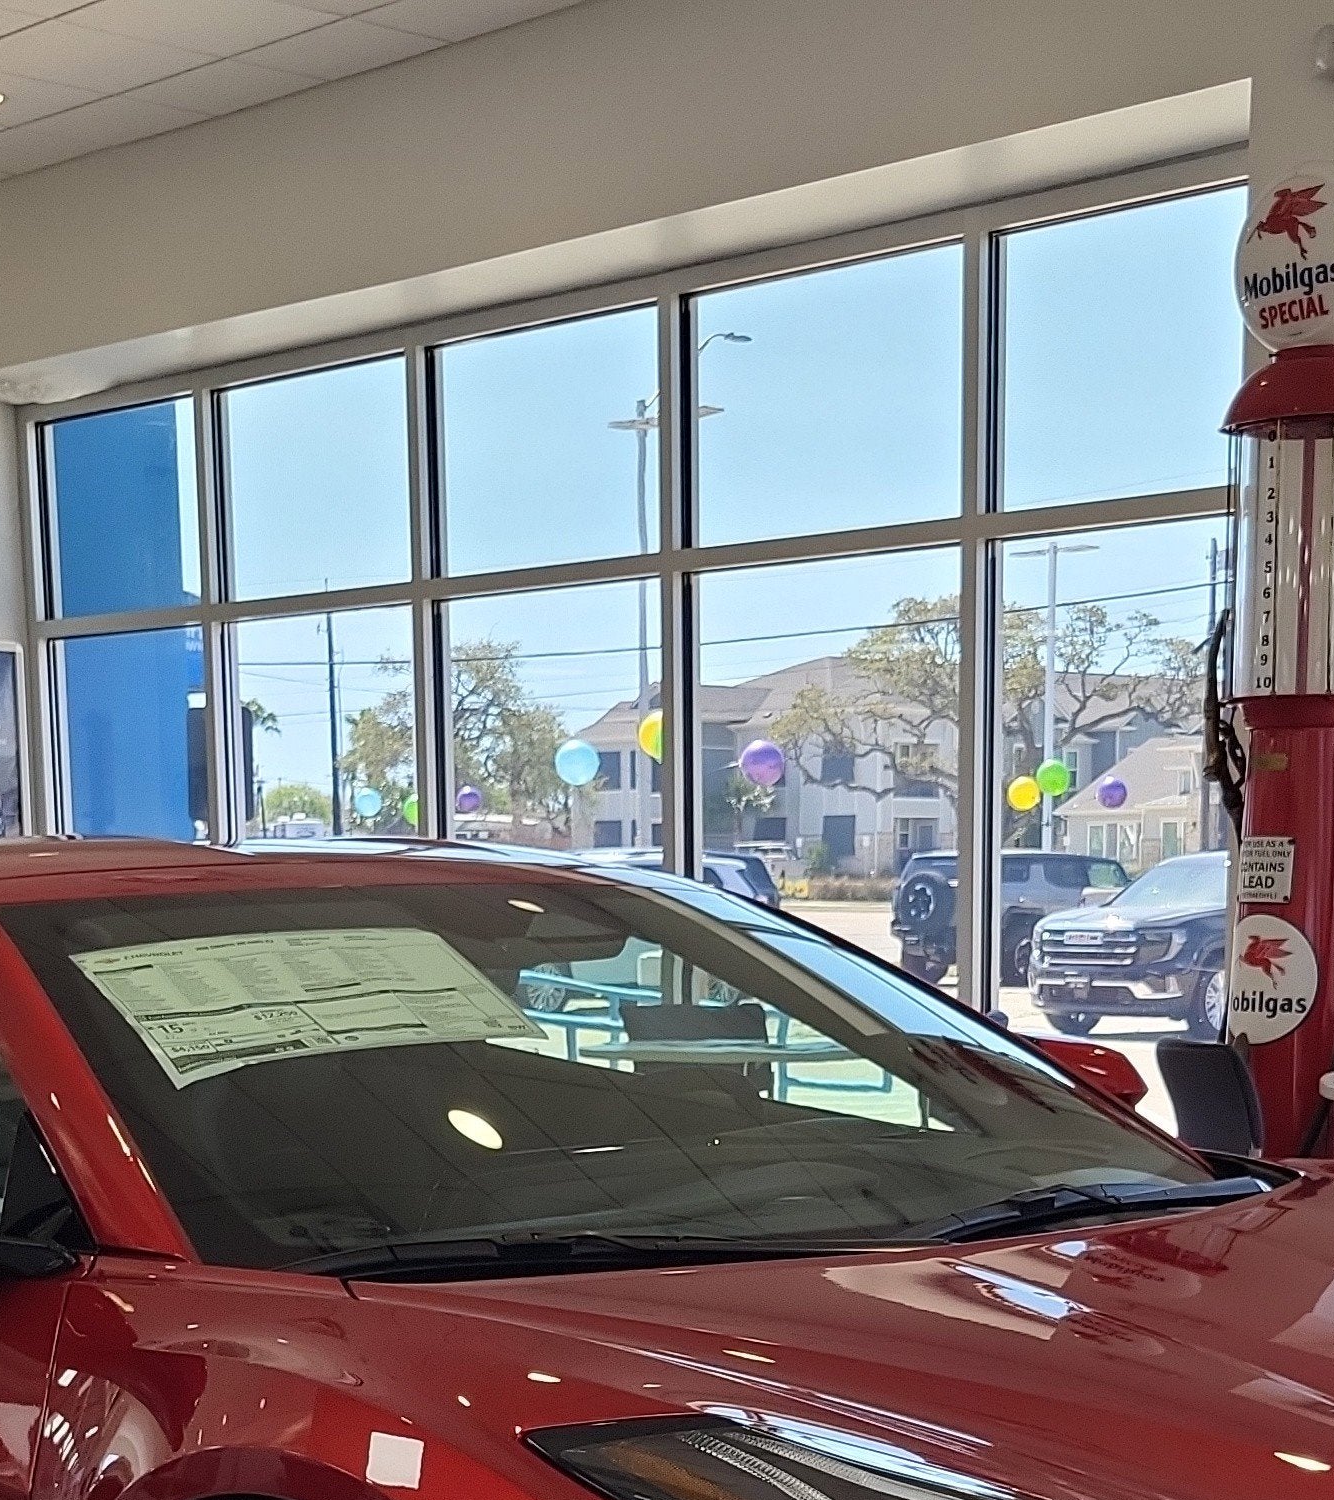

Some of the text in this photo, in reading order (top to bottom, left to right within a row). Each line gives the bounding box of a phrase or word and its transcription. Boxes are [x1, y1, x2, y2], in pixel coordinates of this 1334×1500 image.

[1259, 294, 1330, 330] SPECIAL
[1268, 456, 1275, 469] 1
[1267, 487, 1276, 500] 2
[1266, 511, 1274, 523] 3
[1264, 533, 1273, 545] 4
[1264, 560, 1272, 573] 5
[1262, 587, 1272, 599] 6
[1262, 610, 1271, 623] 7
[1261, 635, 1270, 647] 8
[1260, 654, 1268, 666] 9
[1255, 676, 1272, 688] 10
[1265, 840, 1276, 848] AS
[1272, 850, 1291, 858] ONLY
[1243, 875, 1275, 889] LEAD
[1232, 990, 1307, 1020] obilgas
[158, 1022, 185, 1035] 15
